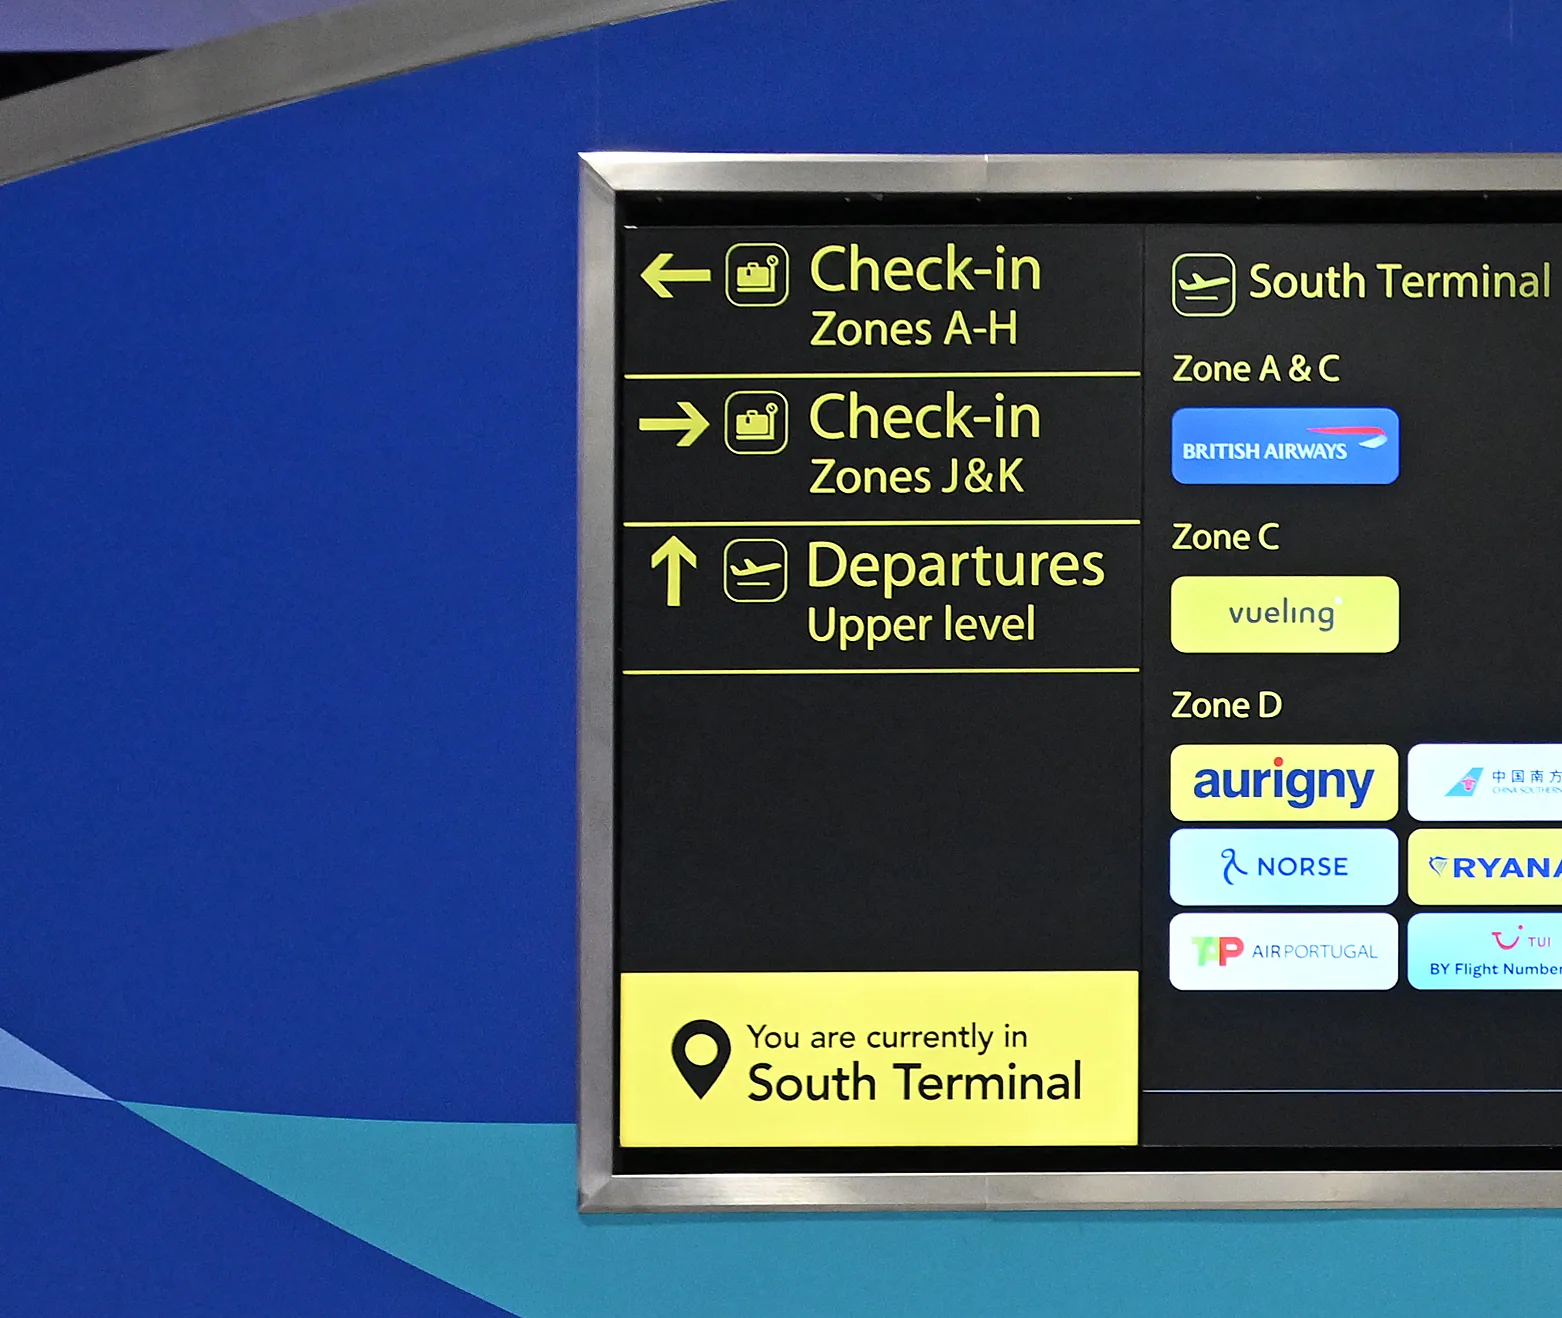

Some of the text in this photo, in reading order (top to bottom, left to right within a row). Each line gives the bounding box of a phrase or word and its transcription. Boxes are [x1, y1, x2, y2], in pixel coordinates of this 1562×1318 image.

[811, 243, 1040, 291] Check-in
[1250, 262, 1549, 298] South Terminal
[811, 310, 1016, 345] Zones A-H
[1173, 355, 1339, 381] Zone A & C
[810, 391, 1039, 439] Check-in
[1183, 443, 1347, 460] BRITISH AIRWAYS
[810, 458, 1024, 493] Zones J&K
[1172, 523, 1279, 550] Zone C
[809, 541, 1104, 599] Departures
[809, 604, 1034, 650] Upper level
[1229, 597, 1333, 631] vueling
[1172, 691, 1281, 718] Zone D
[1194, 757, 1375, 808] aurigny
[1259, 857, 1348, 876] NORSE
[1191, 937, 1244, 966] TAP
[1528, 937, 1550, 947] TUI
[1431, 963, 1449, 975] BY
[1456, 963, 1498, 978] Flight
[747, 1022, 1026, 1055] You are currently in
[748, 1060, 1080, 1101] South Terminal
